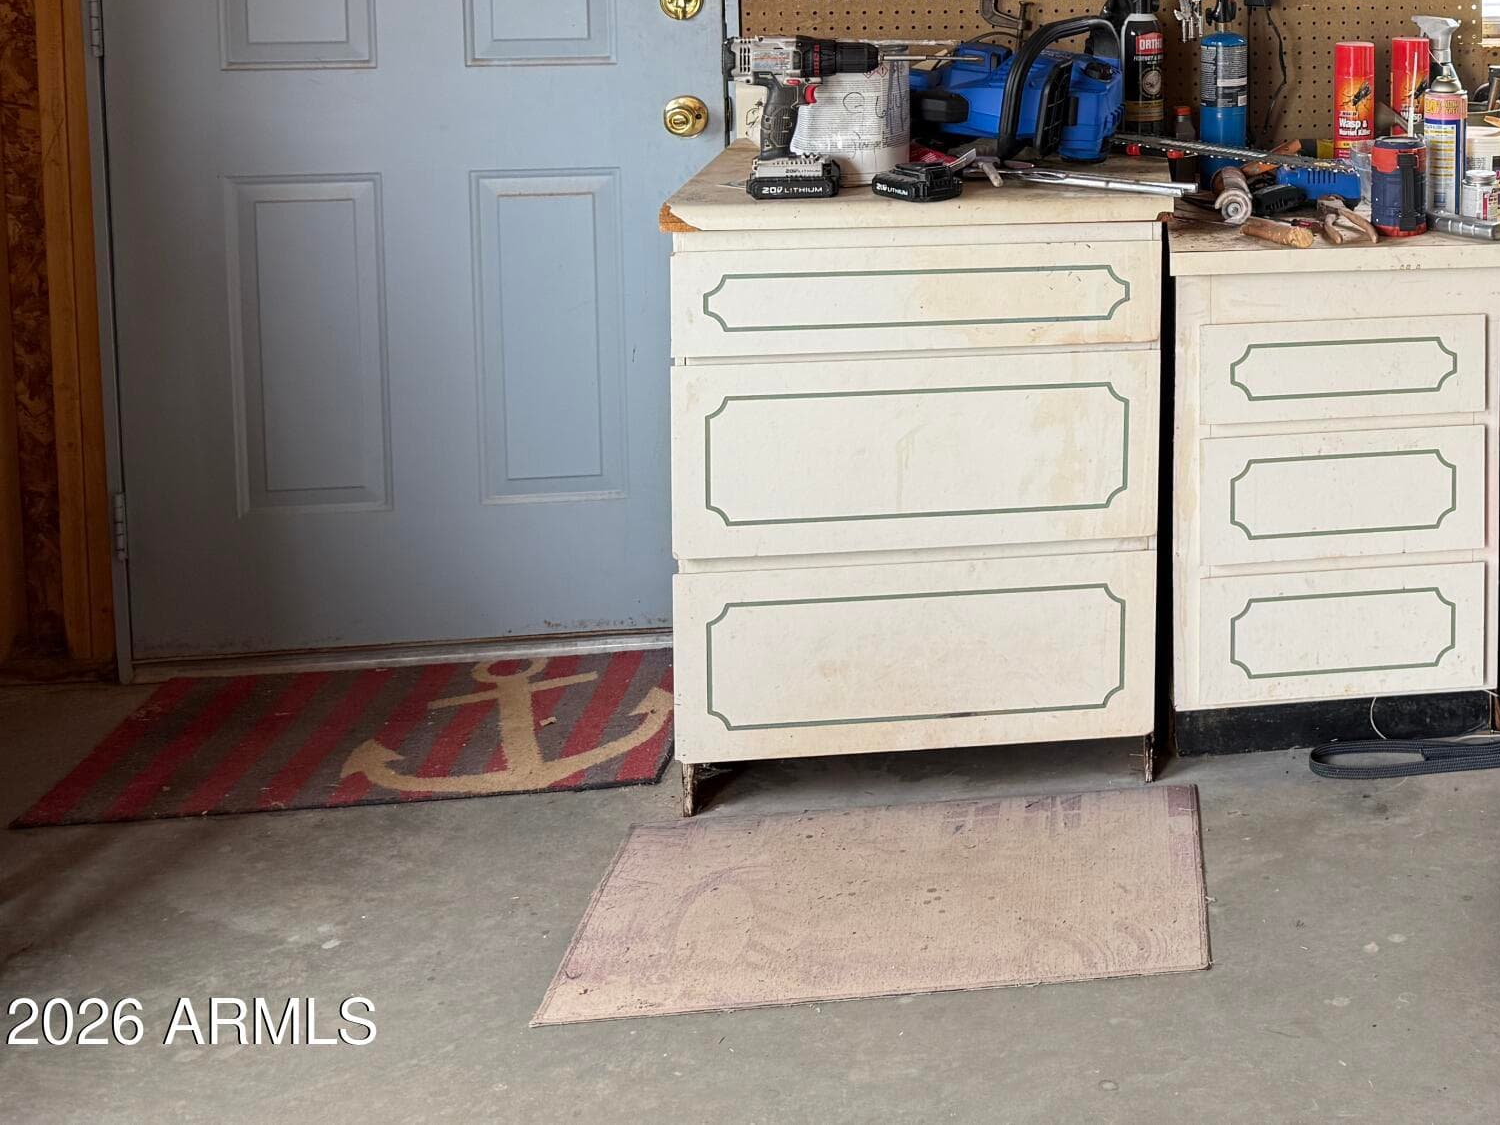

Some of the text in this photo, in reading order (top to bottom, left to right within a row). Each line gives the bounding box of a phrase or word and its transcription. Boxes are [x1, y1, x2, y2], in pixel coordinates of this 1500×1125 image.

[1339, 118, 1368, 130] Wasp &
[761, 186, 823, 194] 20V LITHIUM
[887, 186, 908, 196] LITHIUM
